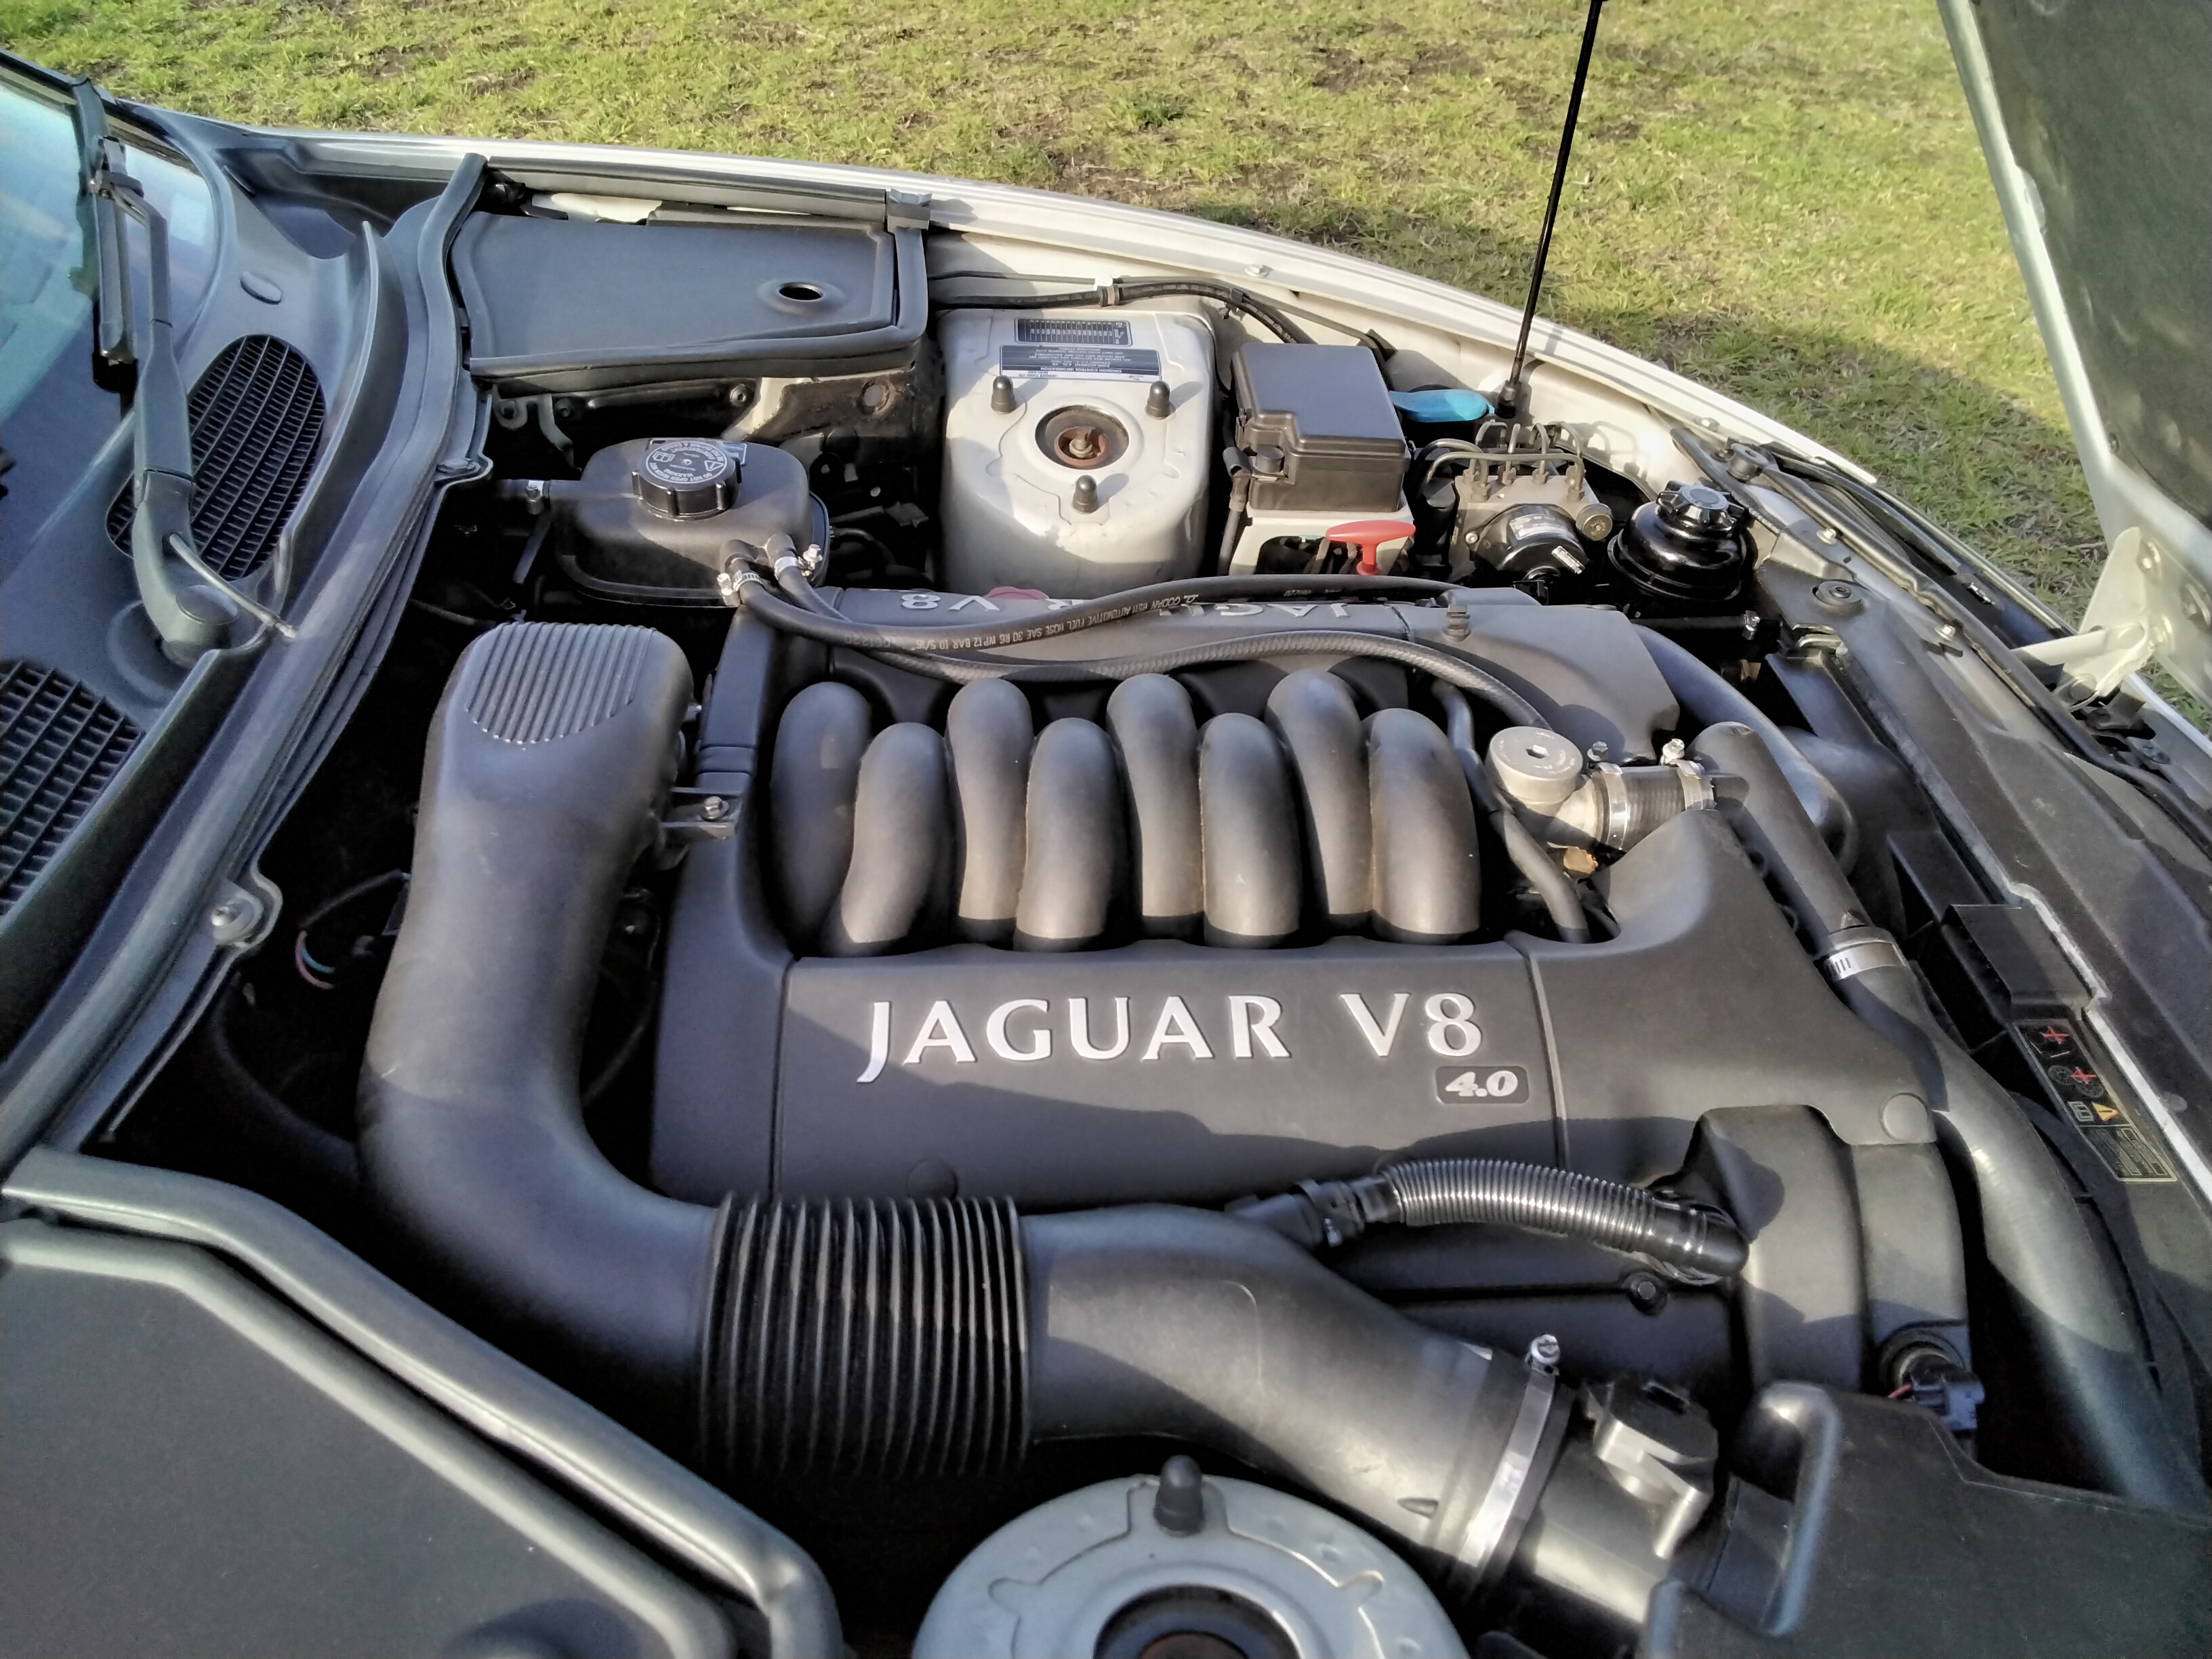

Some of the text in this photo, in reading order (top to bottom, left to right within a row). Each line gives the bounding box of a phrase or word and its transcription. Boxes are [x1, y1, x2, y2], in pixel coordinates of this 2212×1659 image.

[1086, 606, 1132, 626] AUTOMOTIVE
[1045, 623, 1064, 636] HOSE
[1067, 618, 1085, 630] FUEL
[1012, 631, 1023, 642] 30
[1026, 628, 1042, 640] SAE
[951, 638, 971, 649] BAR
[856, 991, 1484, 1084] JAGUAR V8
[1444, 1069, 1519, 1099] 4.0
